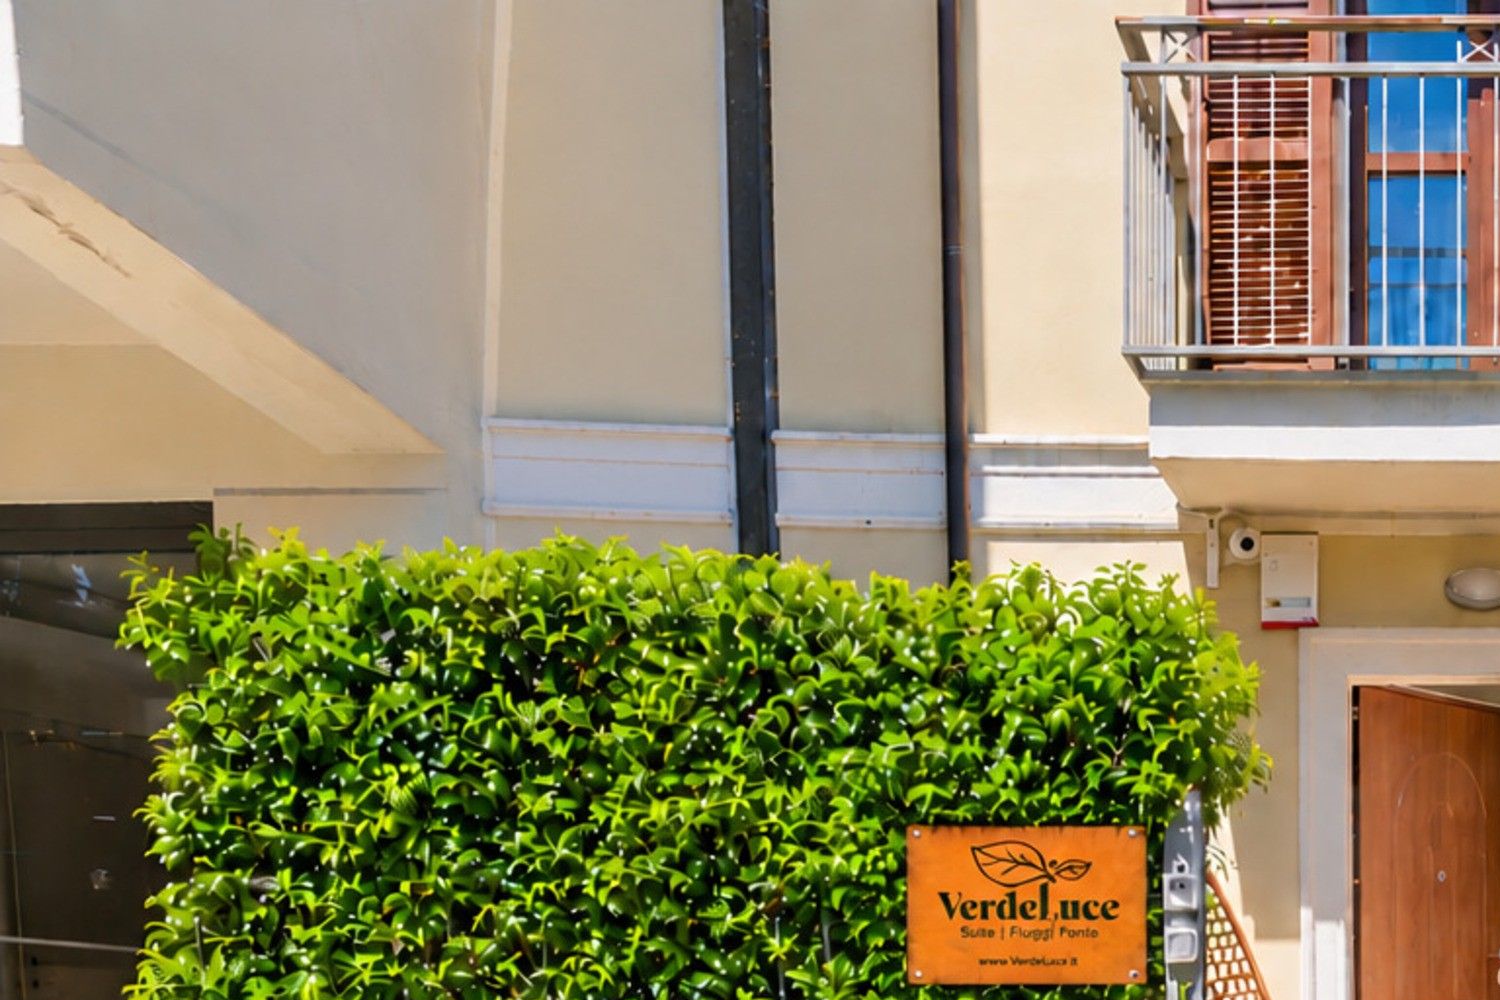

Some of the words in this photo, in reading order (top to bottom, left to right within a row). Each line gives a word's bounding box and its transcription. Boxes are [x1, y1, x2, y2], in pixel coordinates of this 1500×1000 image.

[938, 882, 1120, 921] VerdeLuce
[960, 925, 995, 938] Suite
[1060, 925, 1099, 938] Fonte
